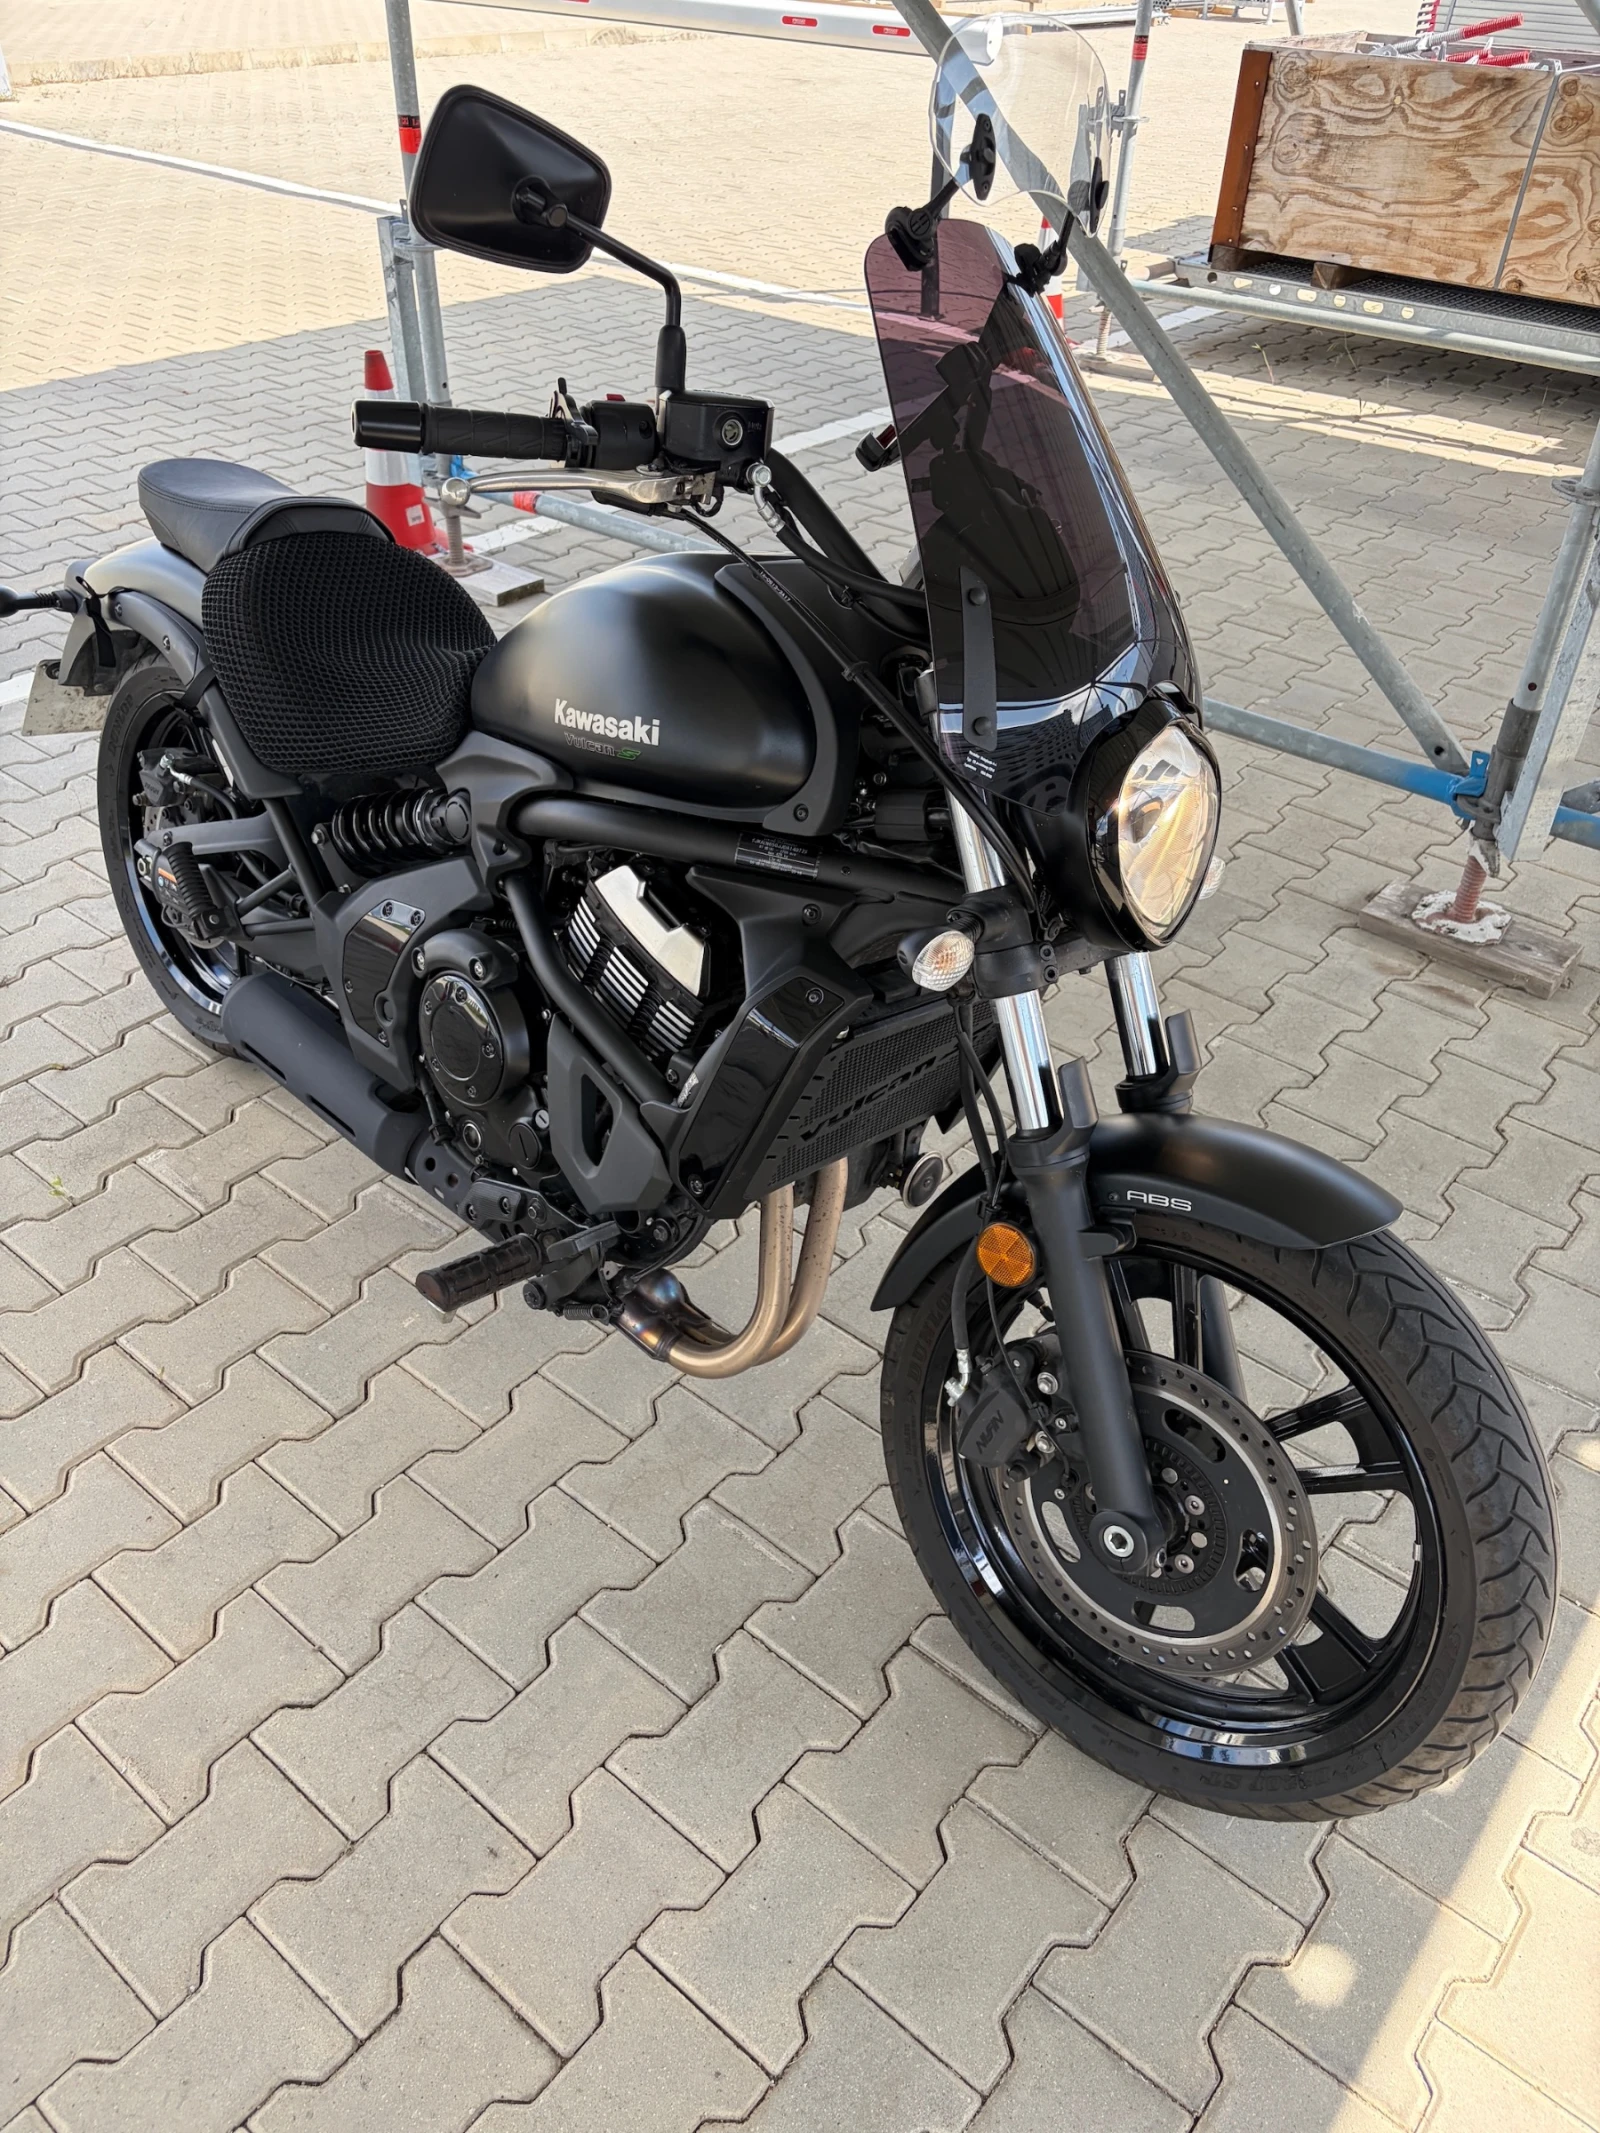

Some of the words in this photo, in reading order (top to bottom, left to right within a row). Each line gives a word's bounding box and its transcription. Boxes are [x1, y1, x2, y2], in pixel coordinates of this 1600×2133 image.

[554, 698, 660, 746] Kawasaki
[563, 731, 616, 757] Vulcan
[616, 747, 641, 760] S
[800, 1056, 937, 1142] Vulcan
[1127, 1189, 1192, 1212] ABS
